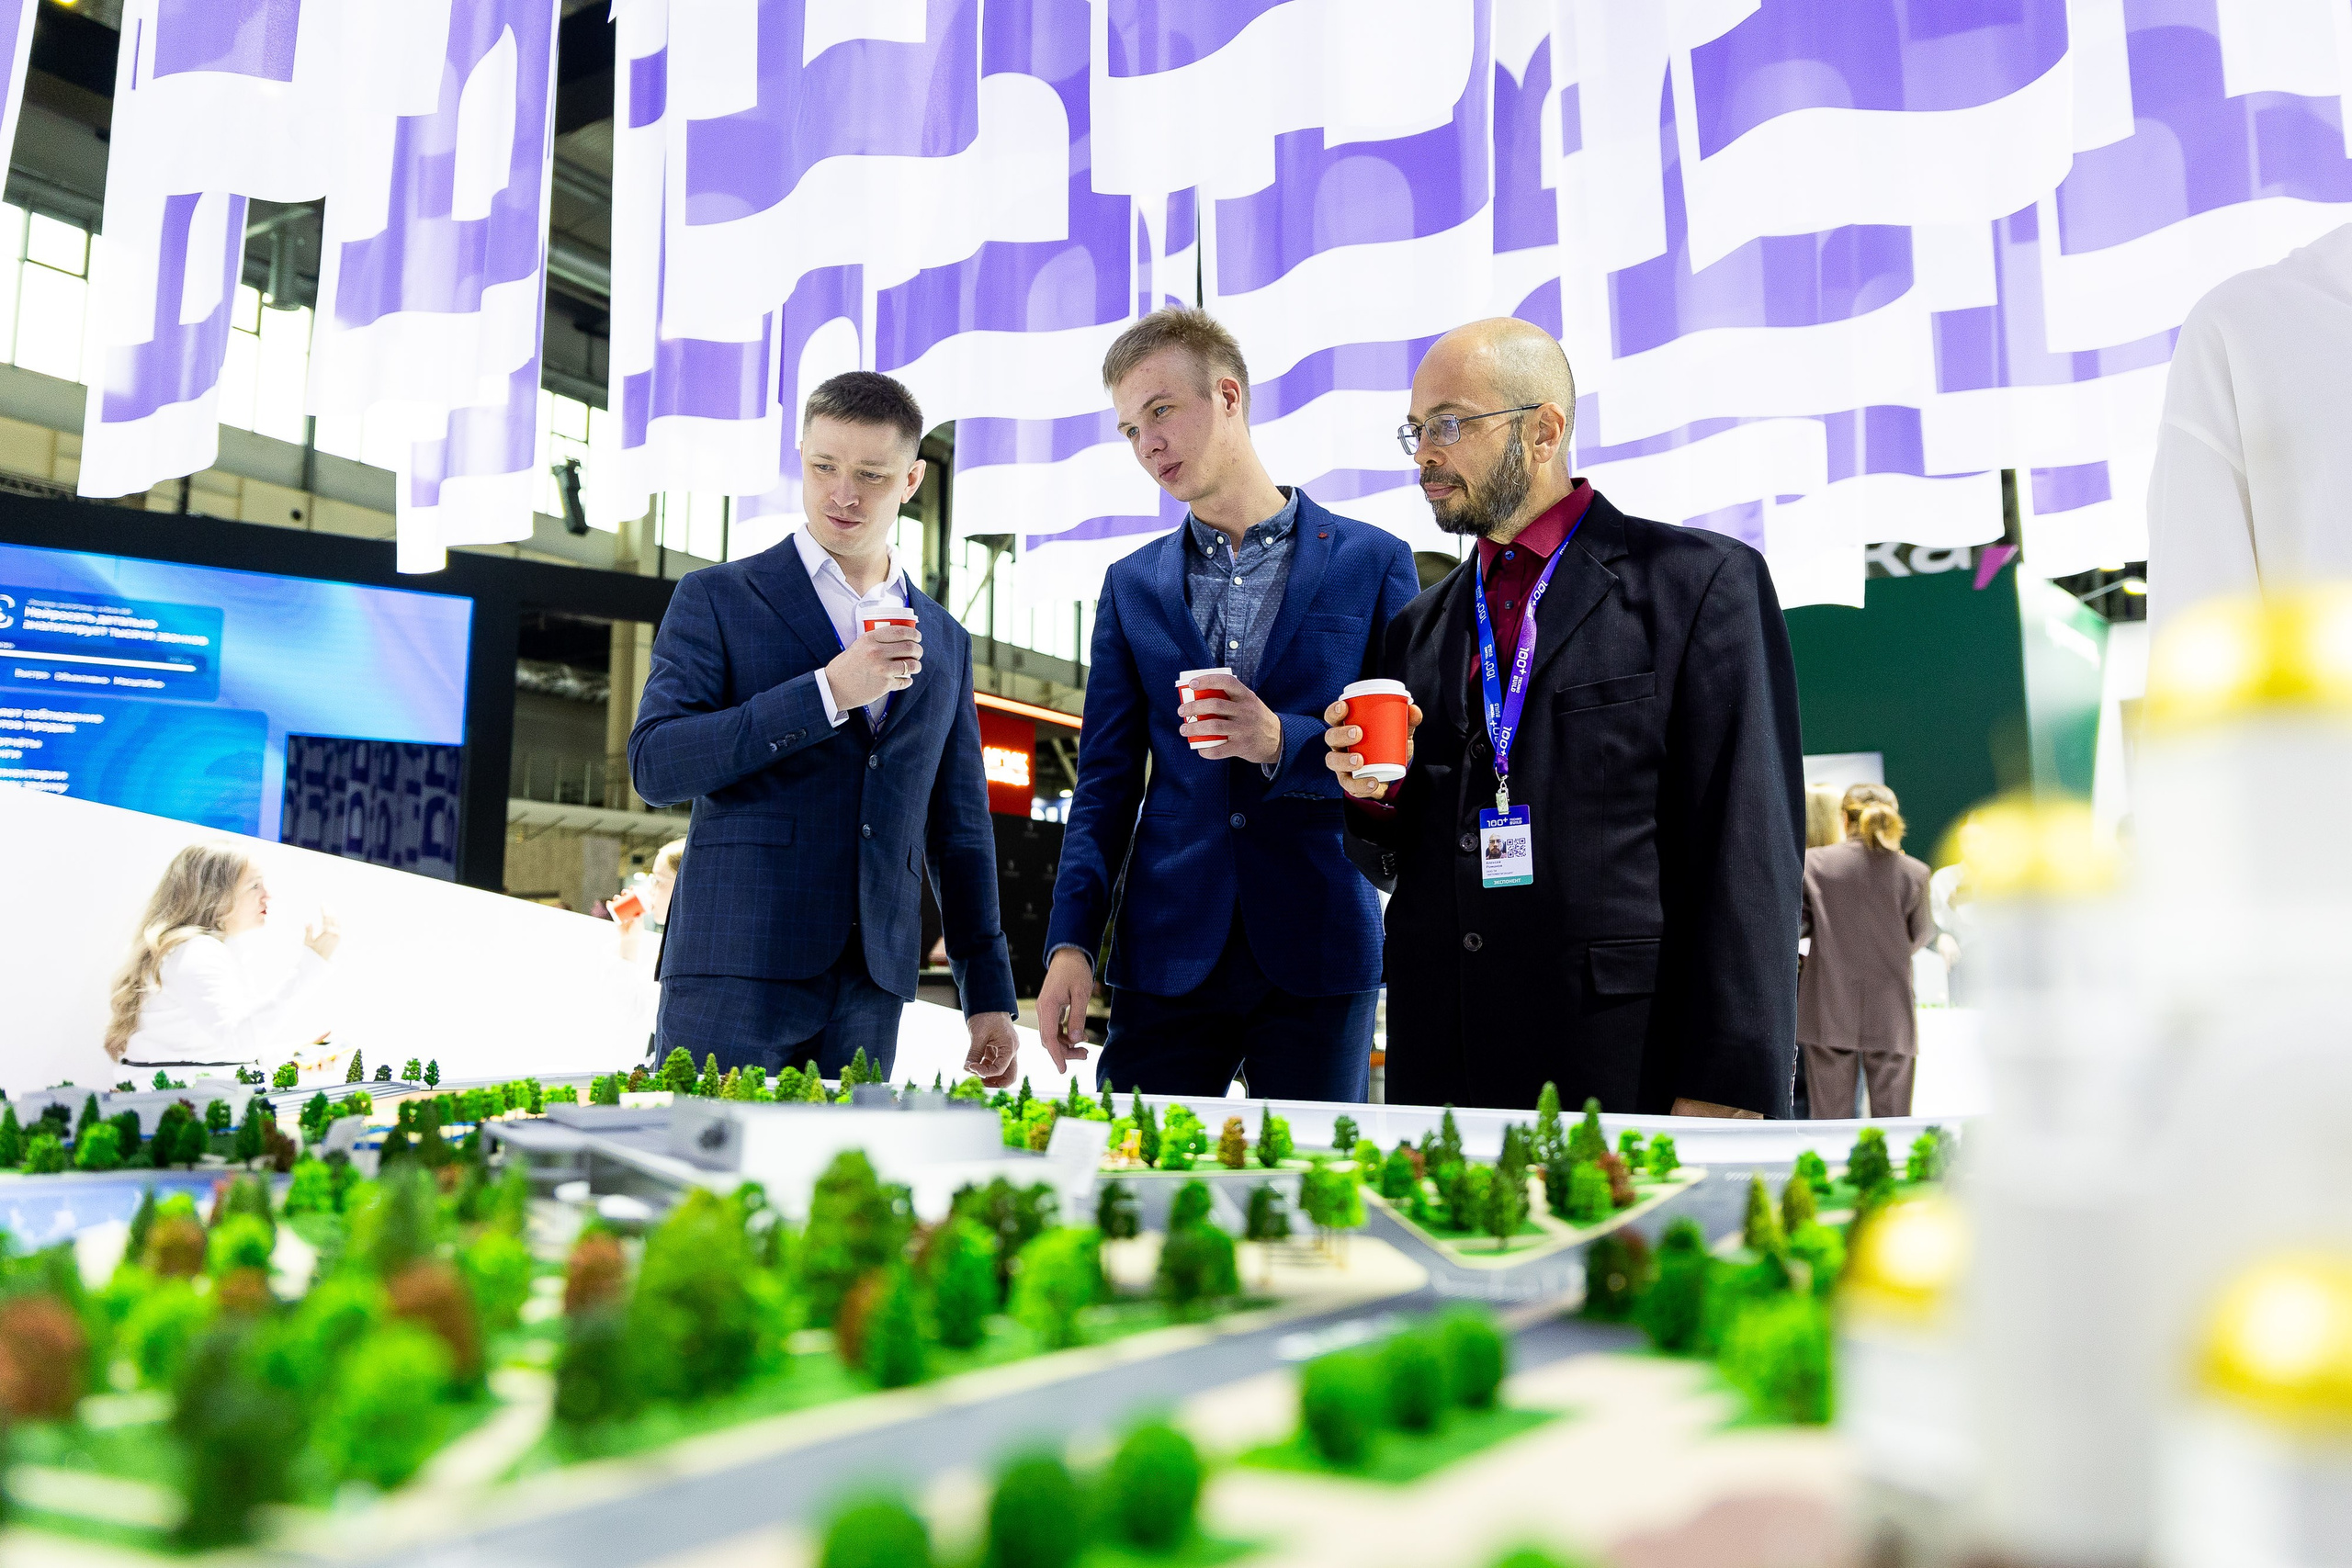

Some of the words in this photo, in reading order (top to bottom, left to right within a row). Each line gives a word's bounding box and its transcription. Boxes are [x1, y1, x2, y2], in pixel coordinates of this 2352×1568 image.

[1532, 580, 1549, 606] 100+
[1476, 603, 1487, 625] 100+
[1484, 660, 1496, 682] 100+
[1516, 648, 1531, 675] 100+
[1499, 726, 1512, 757] 100+
[1487, 818, 1508, 827] 100+
